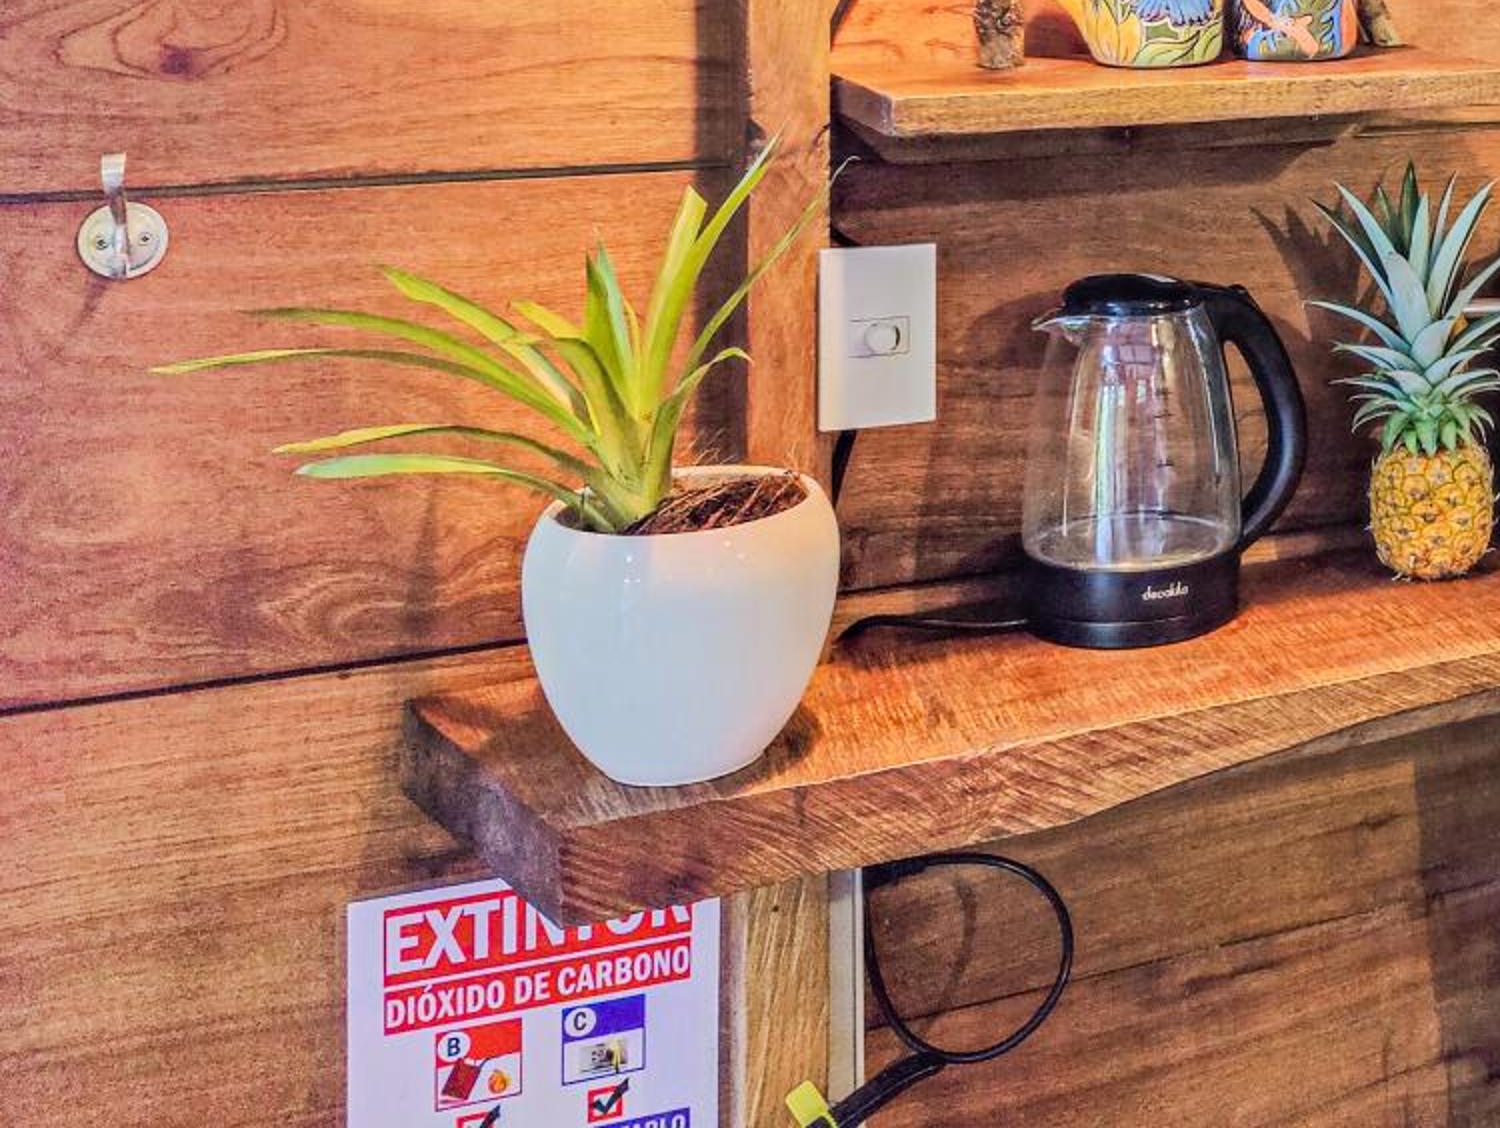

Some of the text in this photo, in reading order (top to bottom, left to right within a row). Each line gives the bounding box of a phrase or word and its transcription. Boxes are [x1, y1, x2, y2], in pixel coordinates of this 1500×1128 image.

[386, 945, 690, 1029] DIÓXIDO DE CARBONO
[573, 1011, 587, 1031] C
[447, 1037, 462, 1058] B
